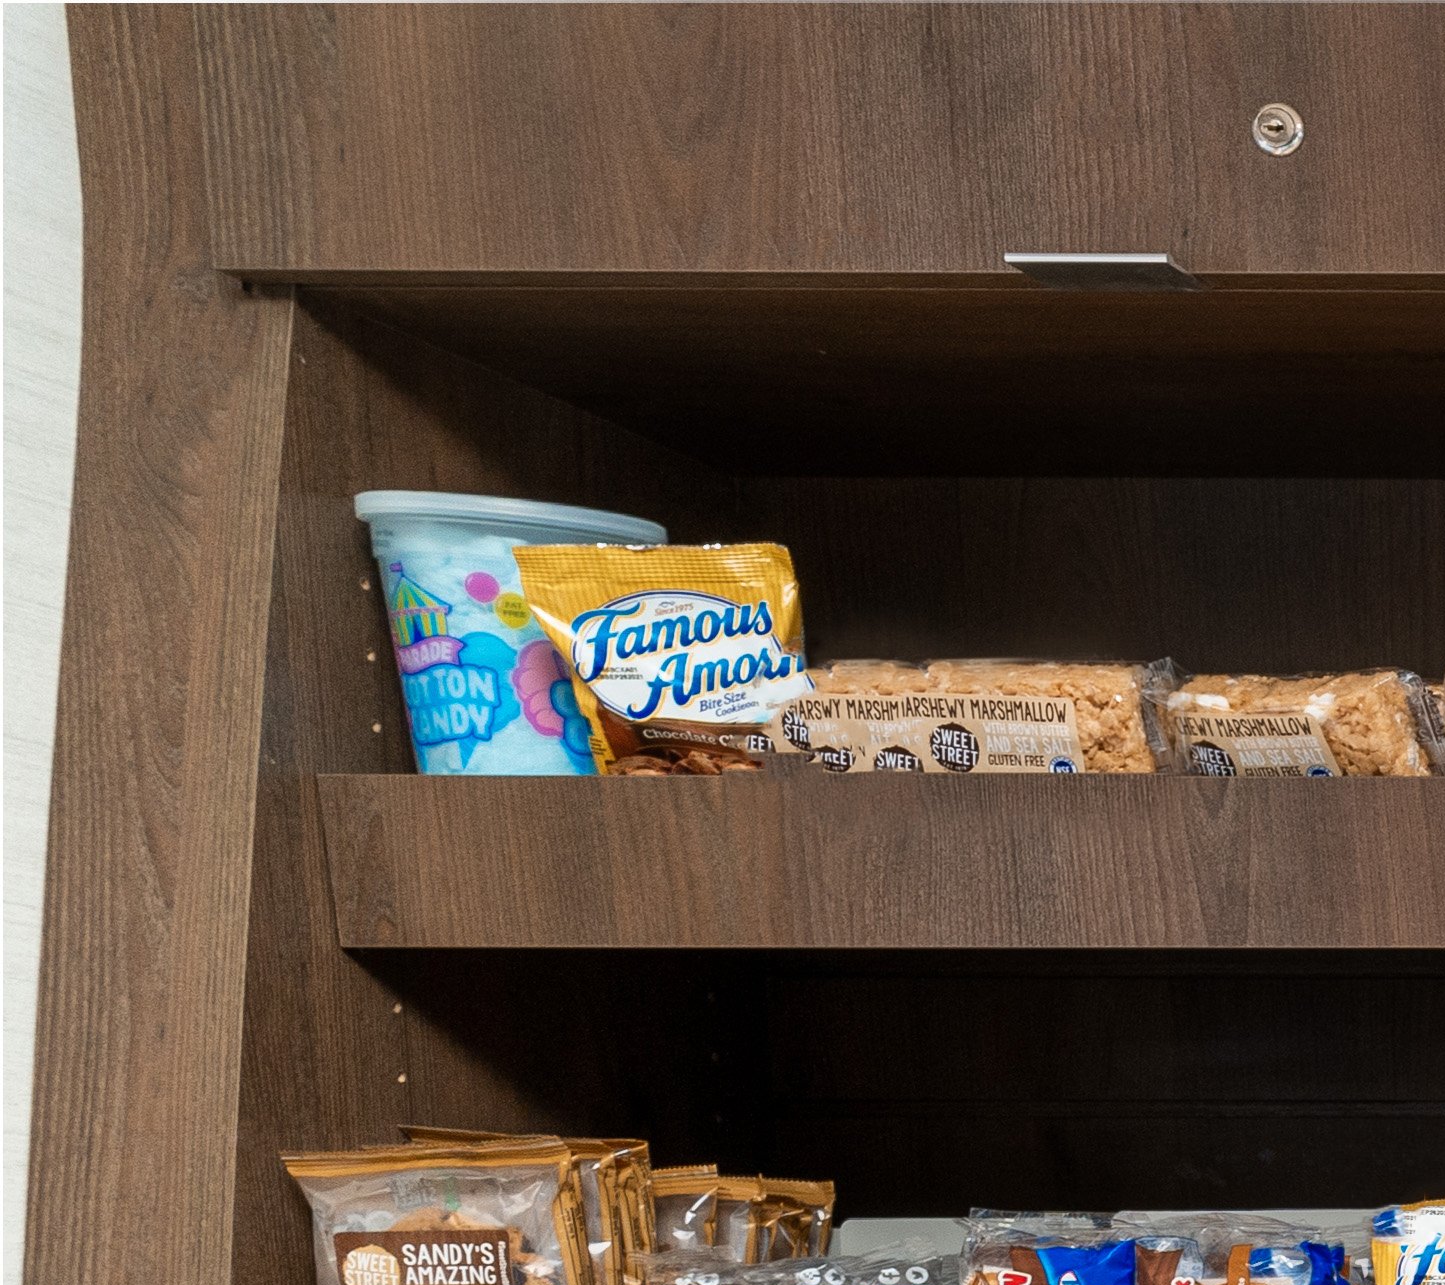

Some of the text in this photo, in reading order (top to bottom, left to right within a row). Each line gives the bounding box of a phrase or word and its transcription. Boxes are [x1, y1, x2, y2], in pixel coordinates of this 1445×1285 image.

[571, 601, 774, 683] Famous
[402, 1242, 494, 1265] SANDY'S
[405, 1266, 496, 1285] AMAZING
